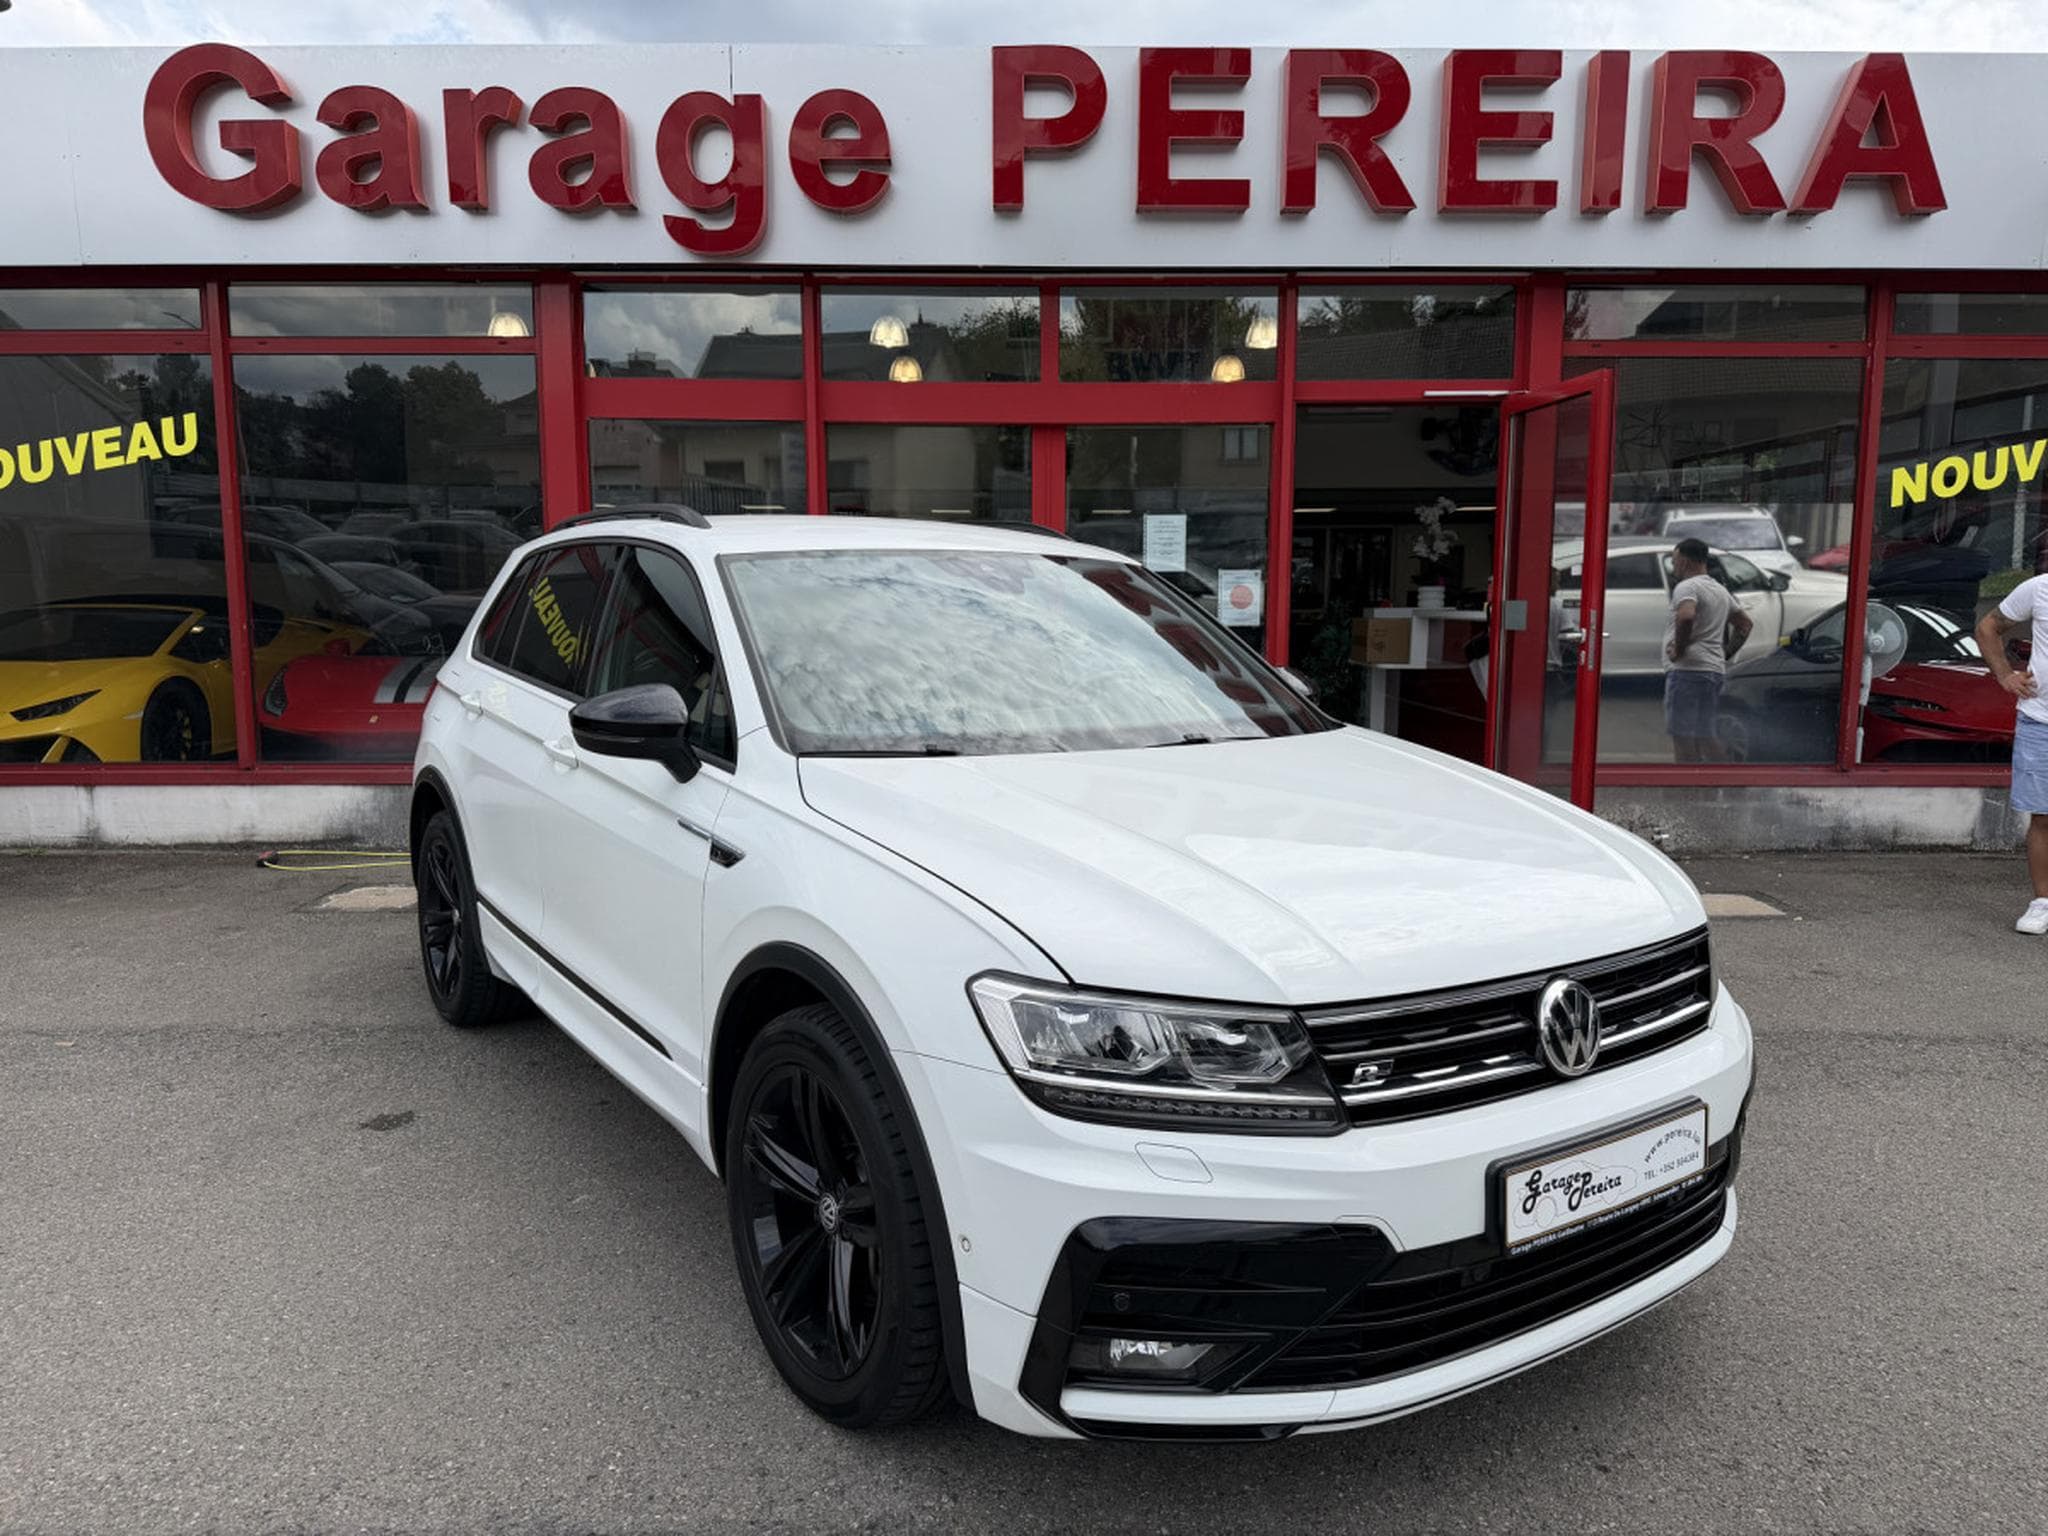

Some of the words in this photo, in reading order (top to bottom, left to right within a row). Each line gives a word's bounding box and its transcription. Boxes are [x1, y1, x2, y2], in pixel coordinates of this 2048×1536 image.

[144, 43, 892, 256] Garage
[992, 46, 1948, 218] PEREIRA
[1891, 438, 2048, 508] NOUV
[1522, 1170, 1582, 1214] Garage
[1568, 1171, 1622, 1212] Pereira
